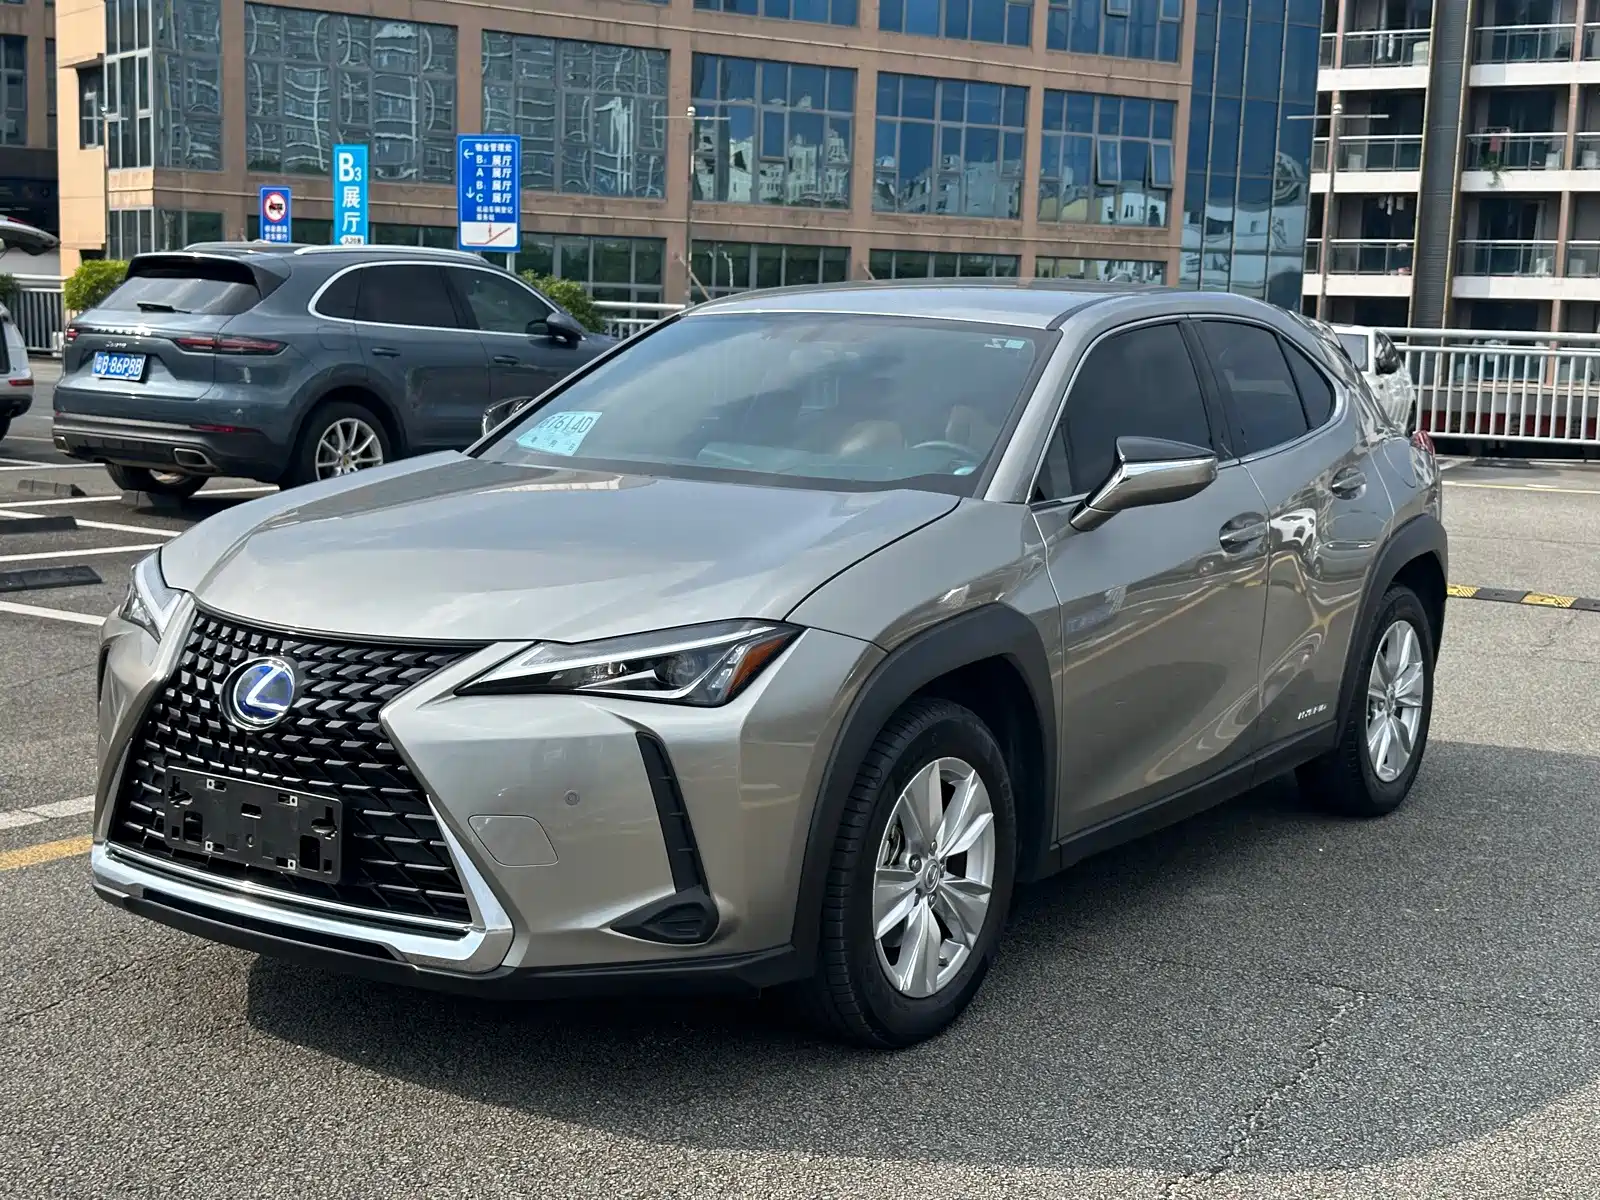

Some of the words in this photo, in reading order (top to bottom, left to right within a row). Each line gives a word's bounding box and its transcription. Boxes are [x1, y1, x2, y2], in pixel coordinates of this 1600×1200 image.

[491, 155, 512, 166] 展厅
[338, 152, 362, 182] B3
[476, 168, 484, 177] A
[491, 167, 512, 178] 展厅
[491, 180, 512, 191] 展厅
[476, 193, 484, 203] C
[491, 193, 512, 203] 展厅
[341, 186, 361, 233] 展厅
